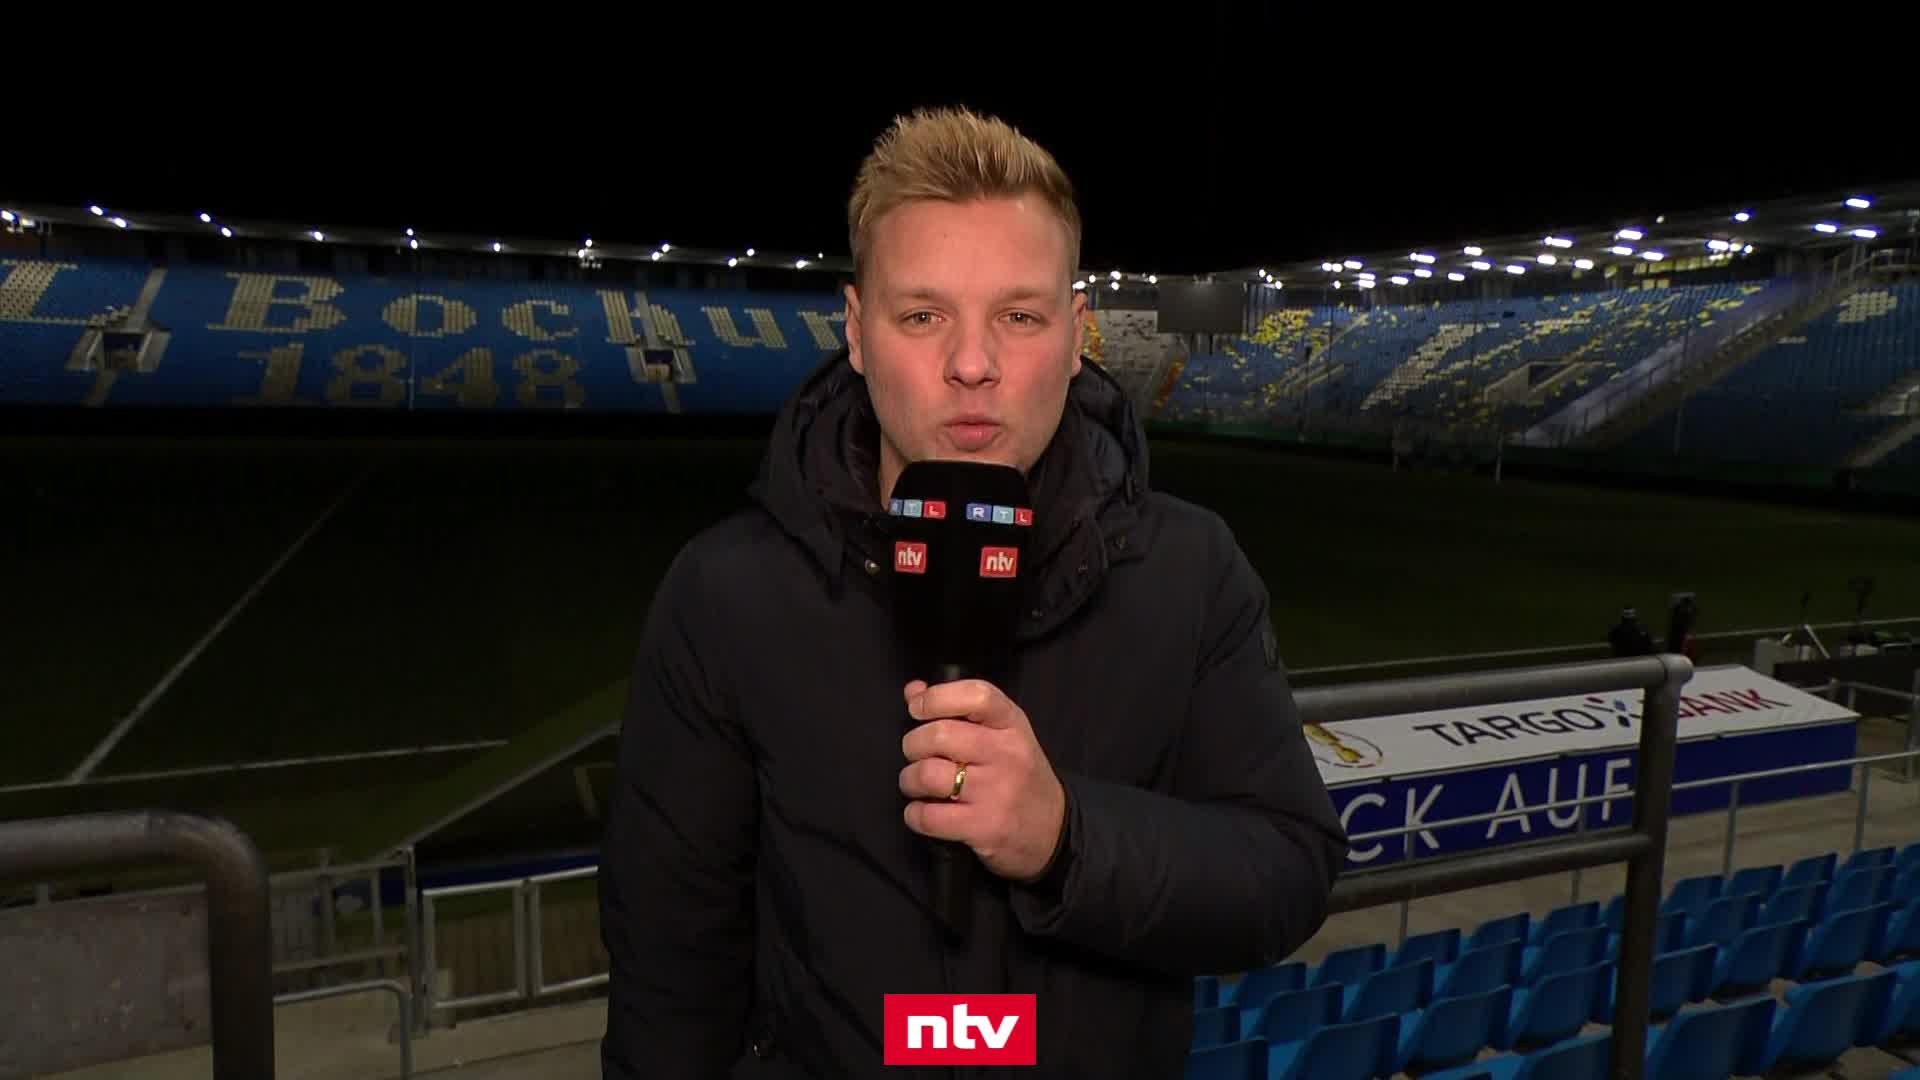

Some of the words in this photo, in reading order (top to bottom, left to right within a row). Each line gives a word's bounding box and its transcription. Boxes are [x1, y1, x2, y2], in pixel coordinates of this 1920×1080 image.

[231, 343, 586, 407] 1848
[972, 505, 1033, 522] RTL
[898, 546, 924, 566] ntv
[986, 551, 1015, 571] ntv
[1412, 708, 1606, 746] TARGO
[1486, 757, 1633, 839] AUF
